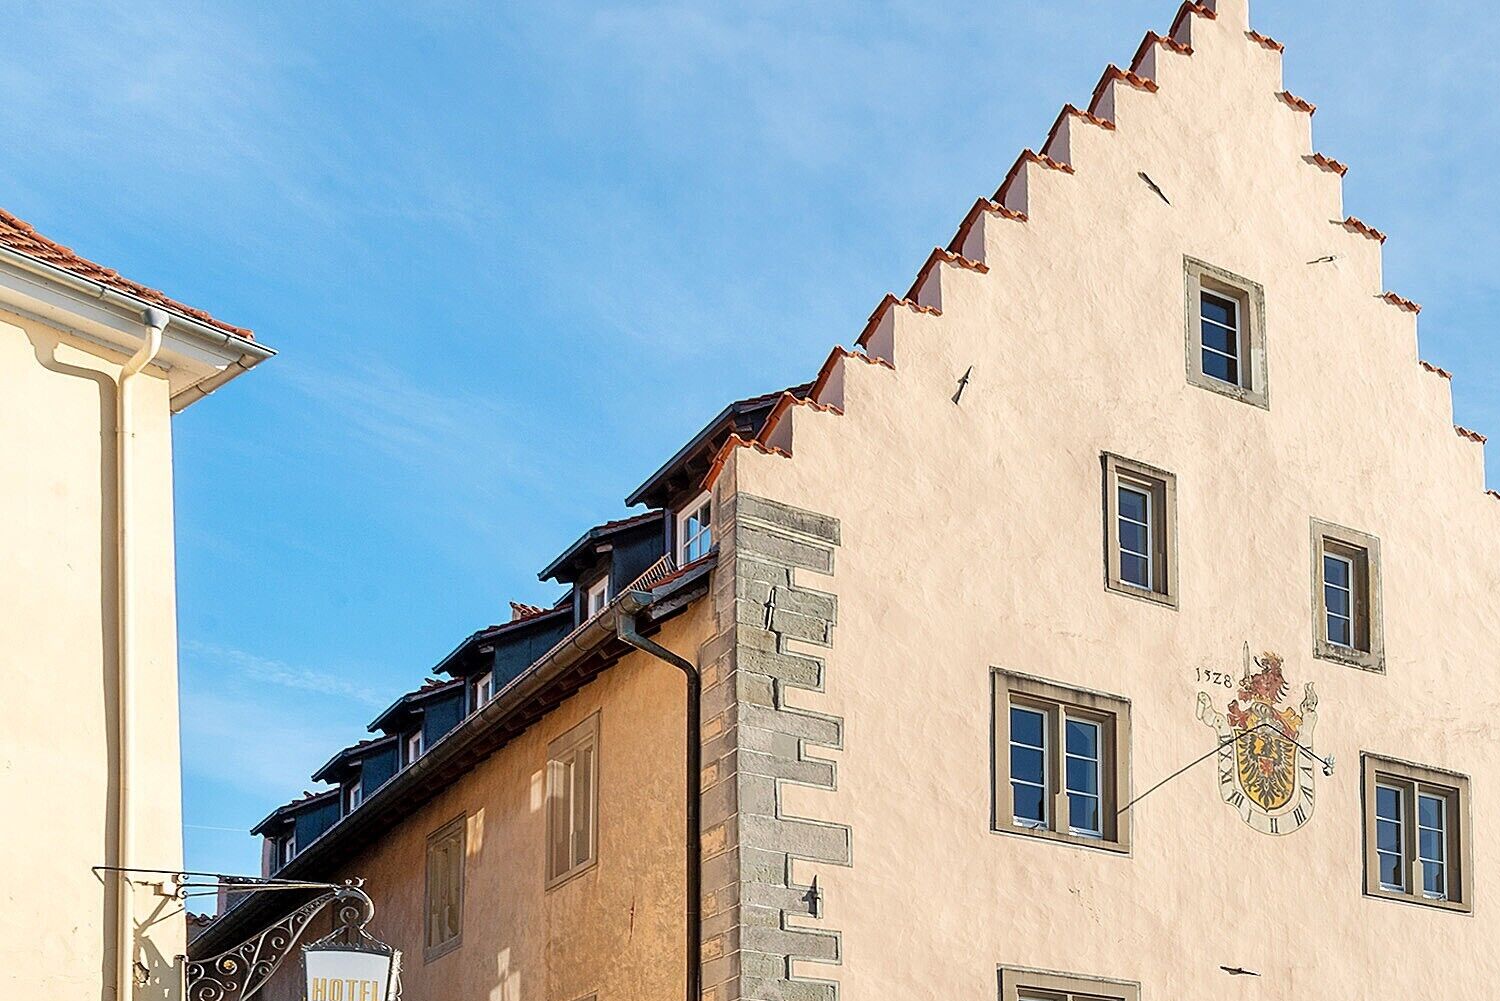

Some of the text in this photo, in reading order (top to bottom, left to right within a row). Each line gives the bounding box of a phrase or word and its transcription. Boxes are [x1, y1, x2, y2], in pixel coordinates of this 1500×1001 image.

[1196, 667, 1233, 688] 1528
[1246, 809, 1254, 823] I
[1293, 805, 1307, 826] III
[1270, 817, 1280, 834] II
